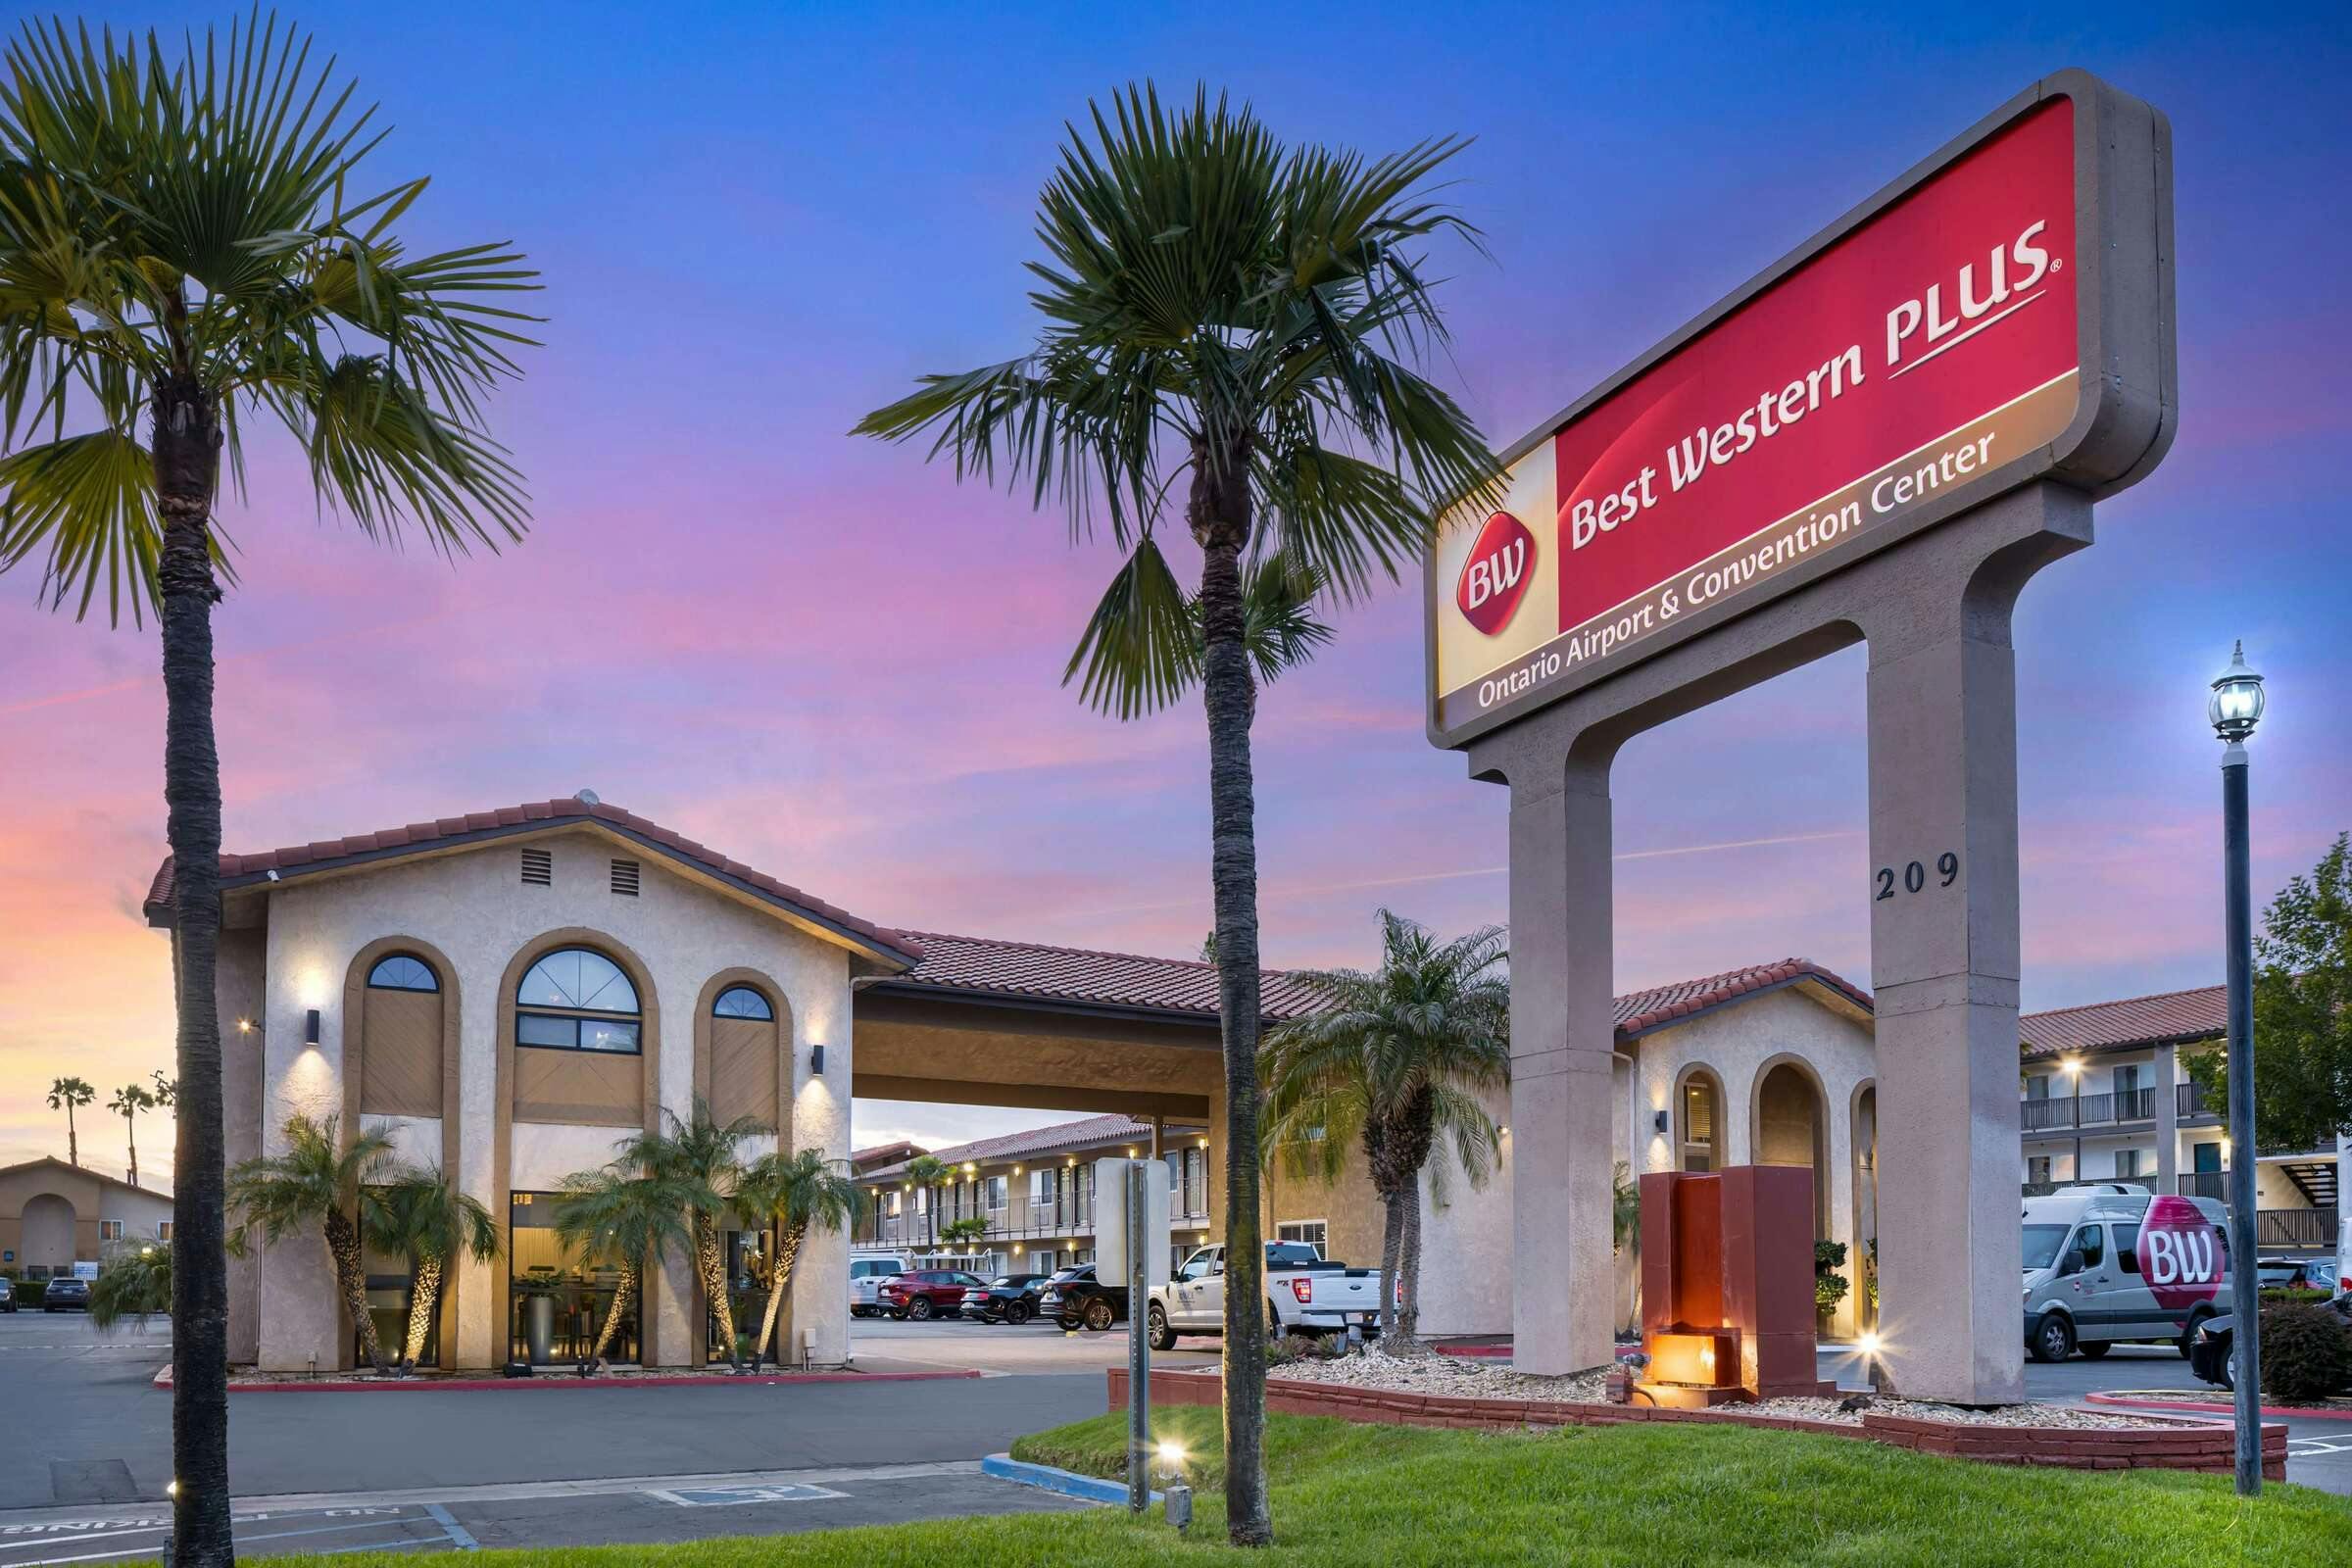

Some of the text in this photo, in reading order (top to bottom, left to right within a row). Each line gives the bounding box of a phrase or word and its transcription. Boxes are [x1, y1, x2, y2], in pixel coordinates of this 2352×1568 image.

[1571, 466, 1658, 551] Best
[1666, 344, 1865, 493] Western
[1468, 537, 1525, 611] BW
[1478, 431, 1995, 708] Ontario Airport & Convention Center
[1876, 852, 1958, 902] 209
[2146, 1230, 2213, 1285] BW
